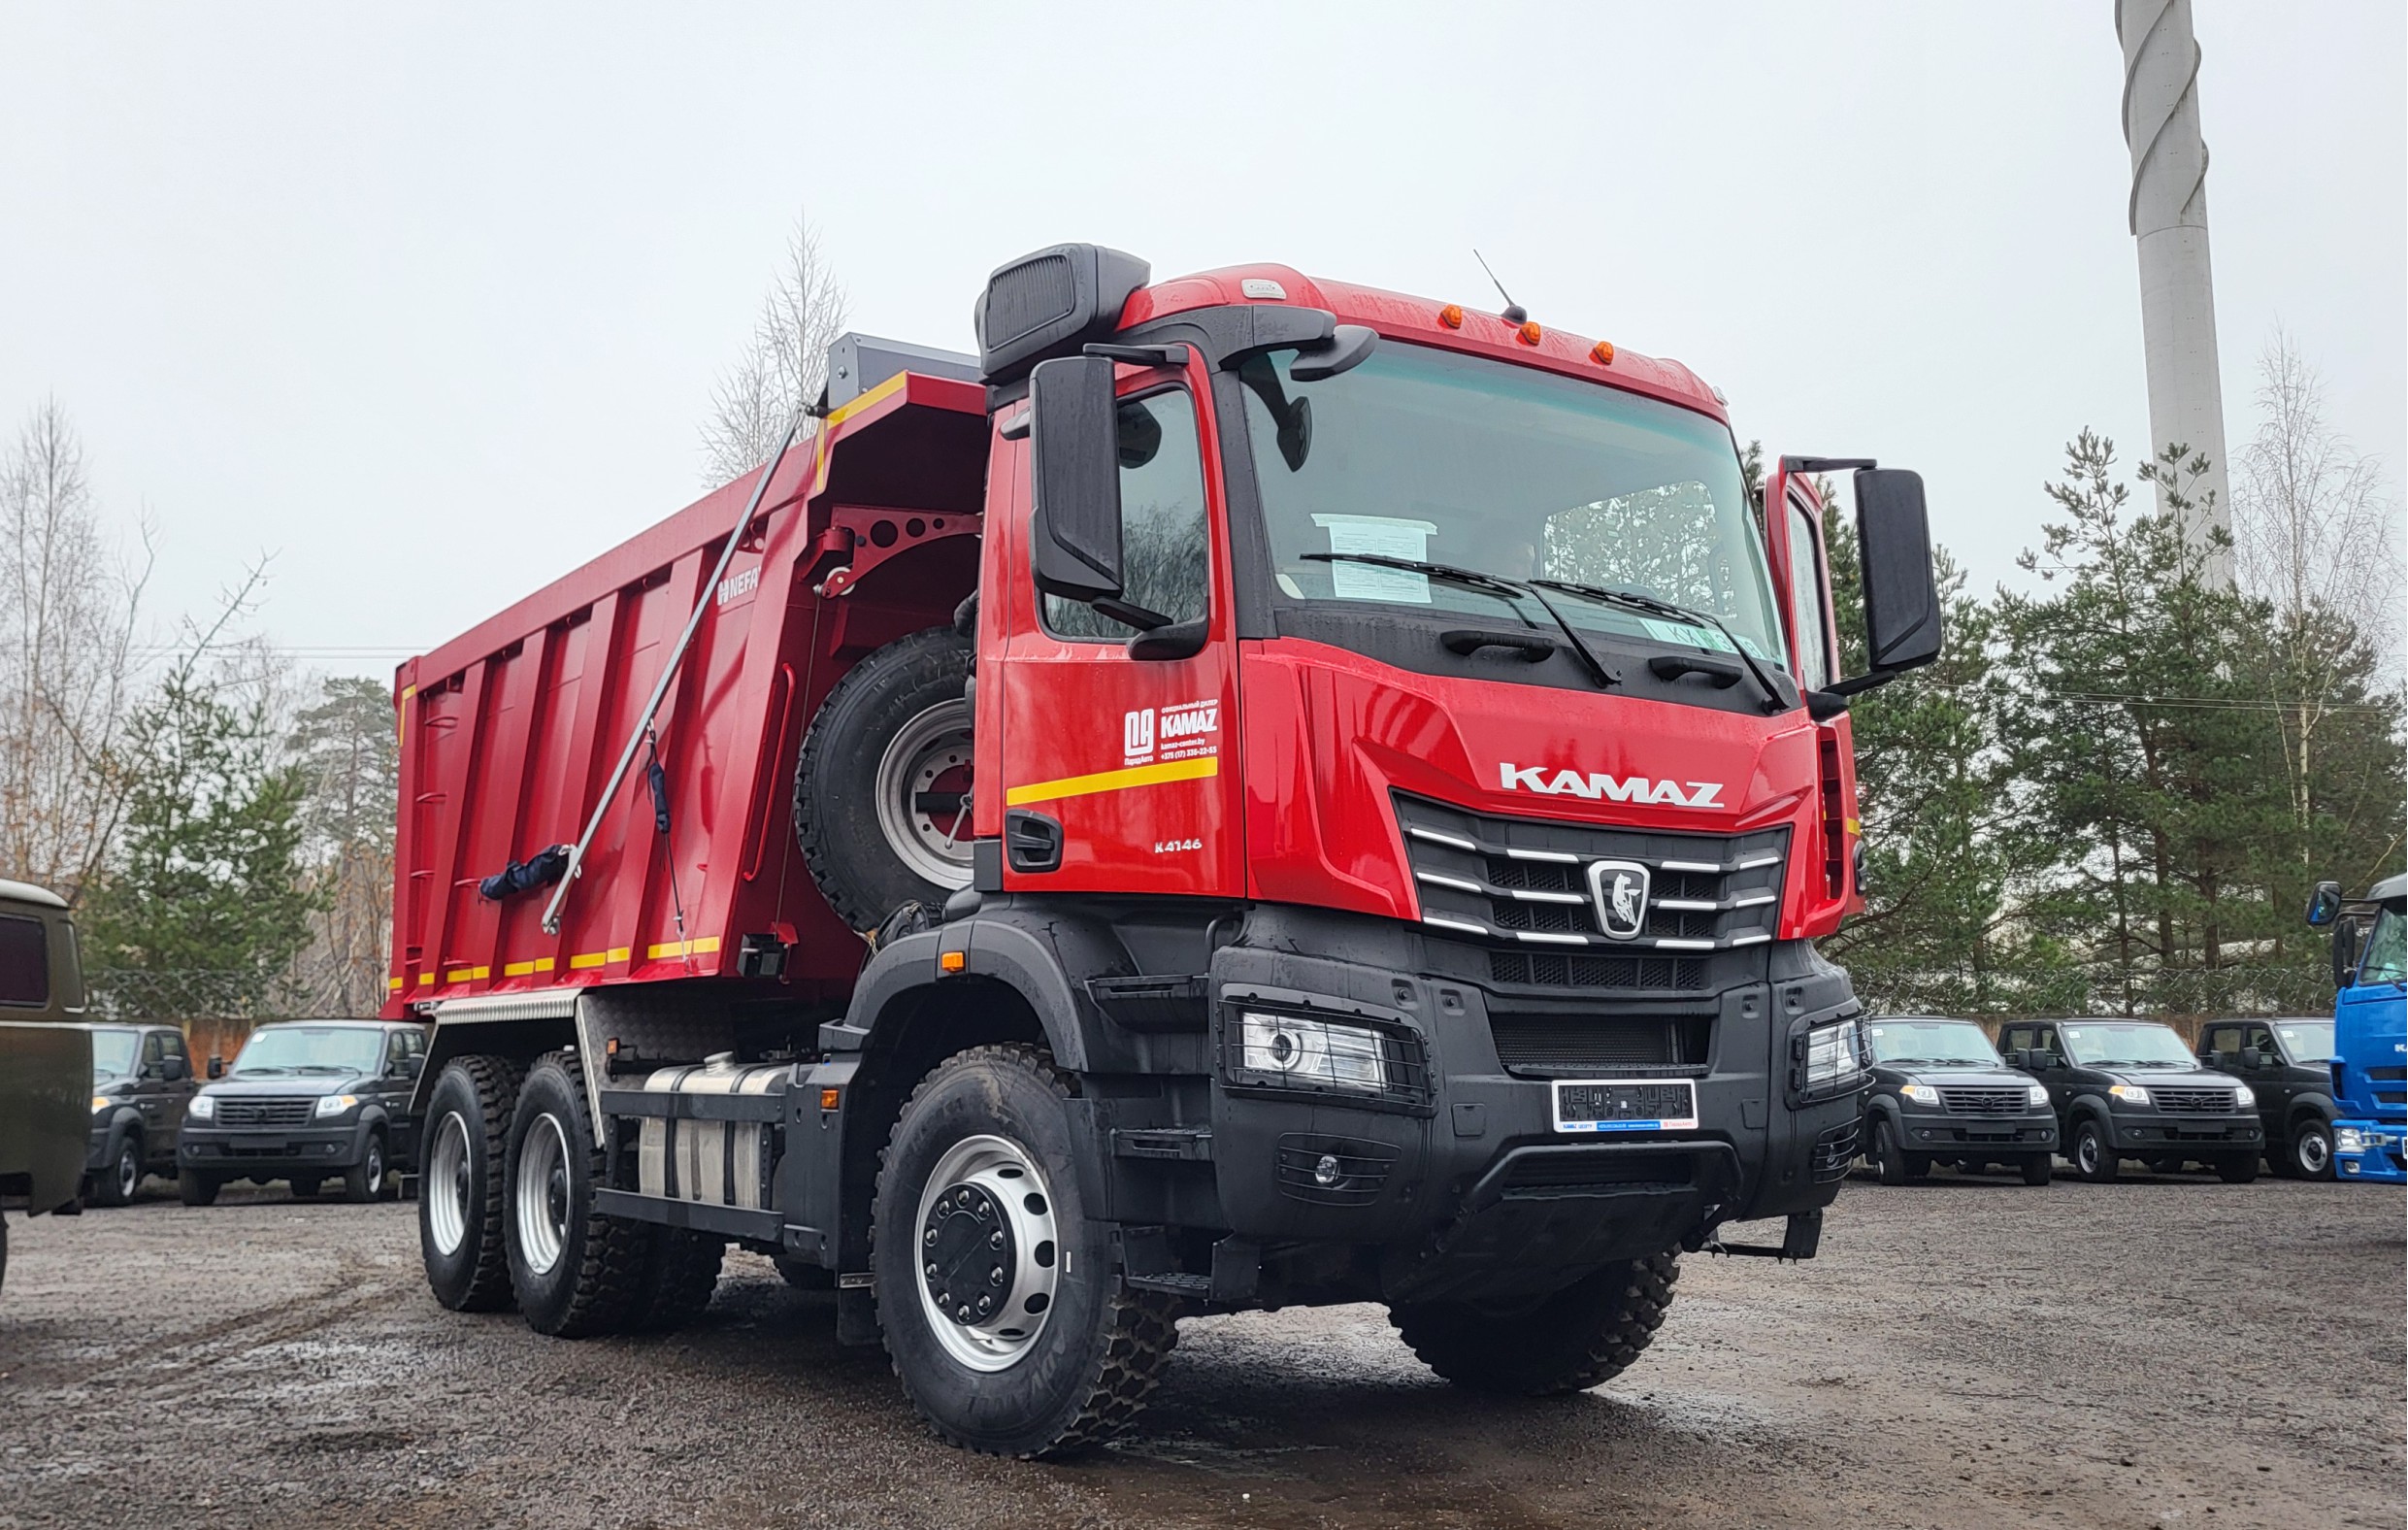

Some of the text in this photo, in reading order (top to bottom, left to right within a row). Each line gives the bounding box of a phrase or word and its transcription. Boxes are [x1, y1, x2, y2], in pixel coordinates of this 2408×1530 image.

[728, 565, 761, 599] NEFA
[1160, 708, 1217, 739] KAMAZ
[1499, 762, 1725, 808] KAMAZ
